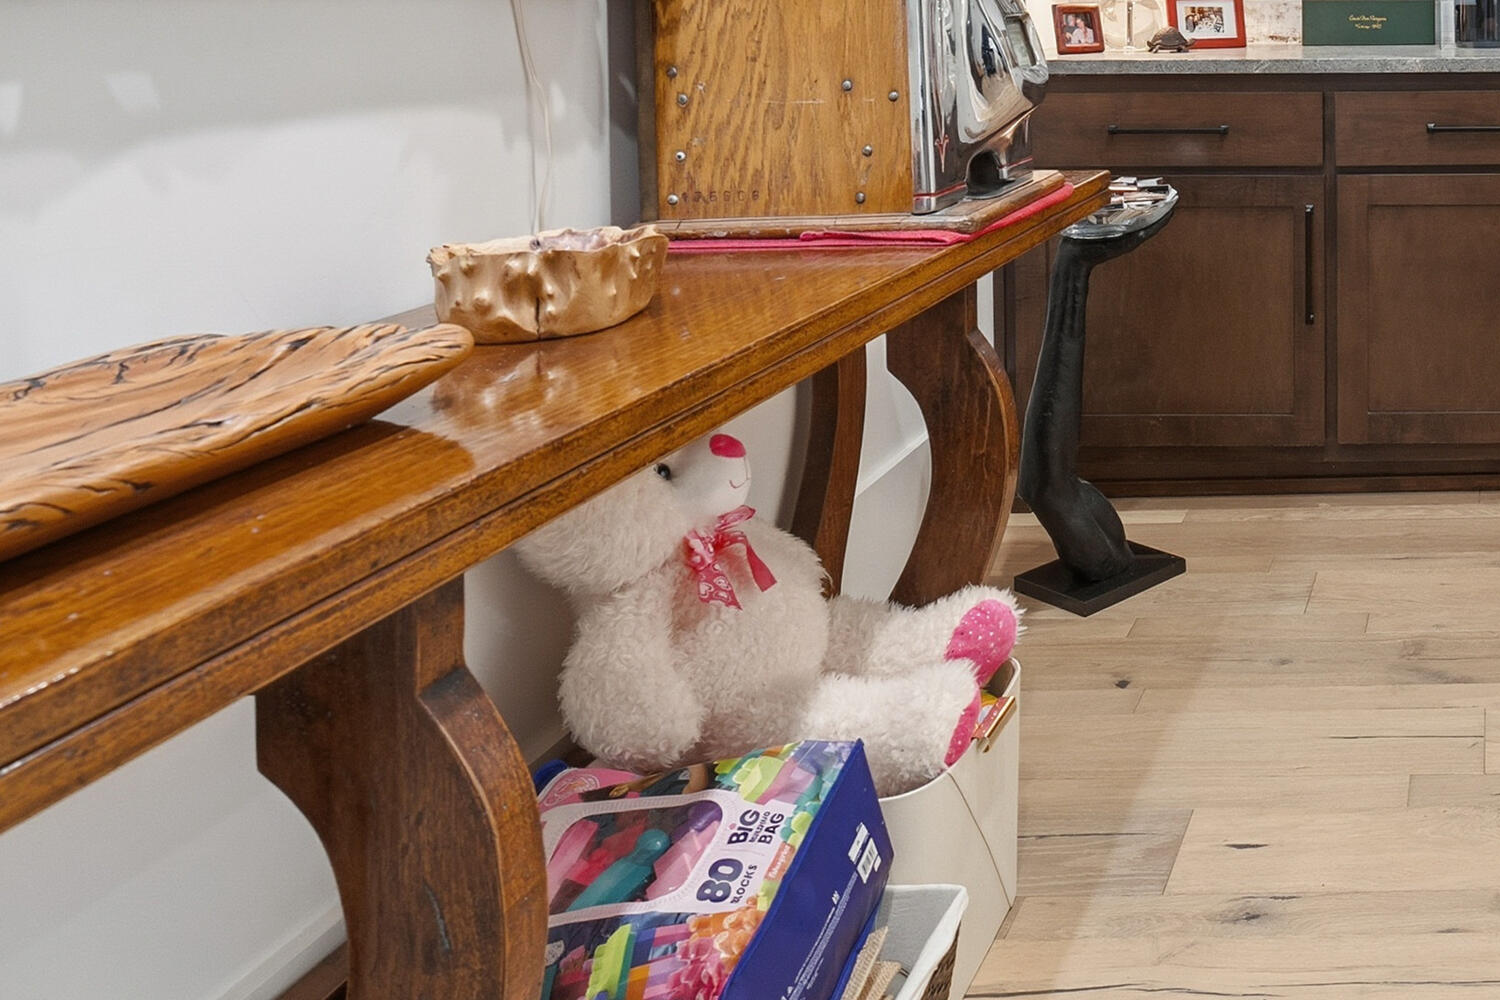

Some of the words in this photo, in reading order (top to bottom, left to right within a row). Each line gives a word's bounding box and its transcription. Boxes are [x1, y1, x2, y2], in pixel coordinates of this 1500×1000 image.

[757, 813, 784, 845] BAG
[696, 858, 743, 903] 80
[730, 864, 758, 904] BLOCKS
